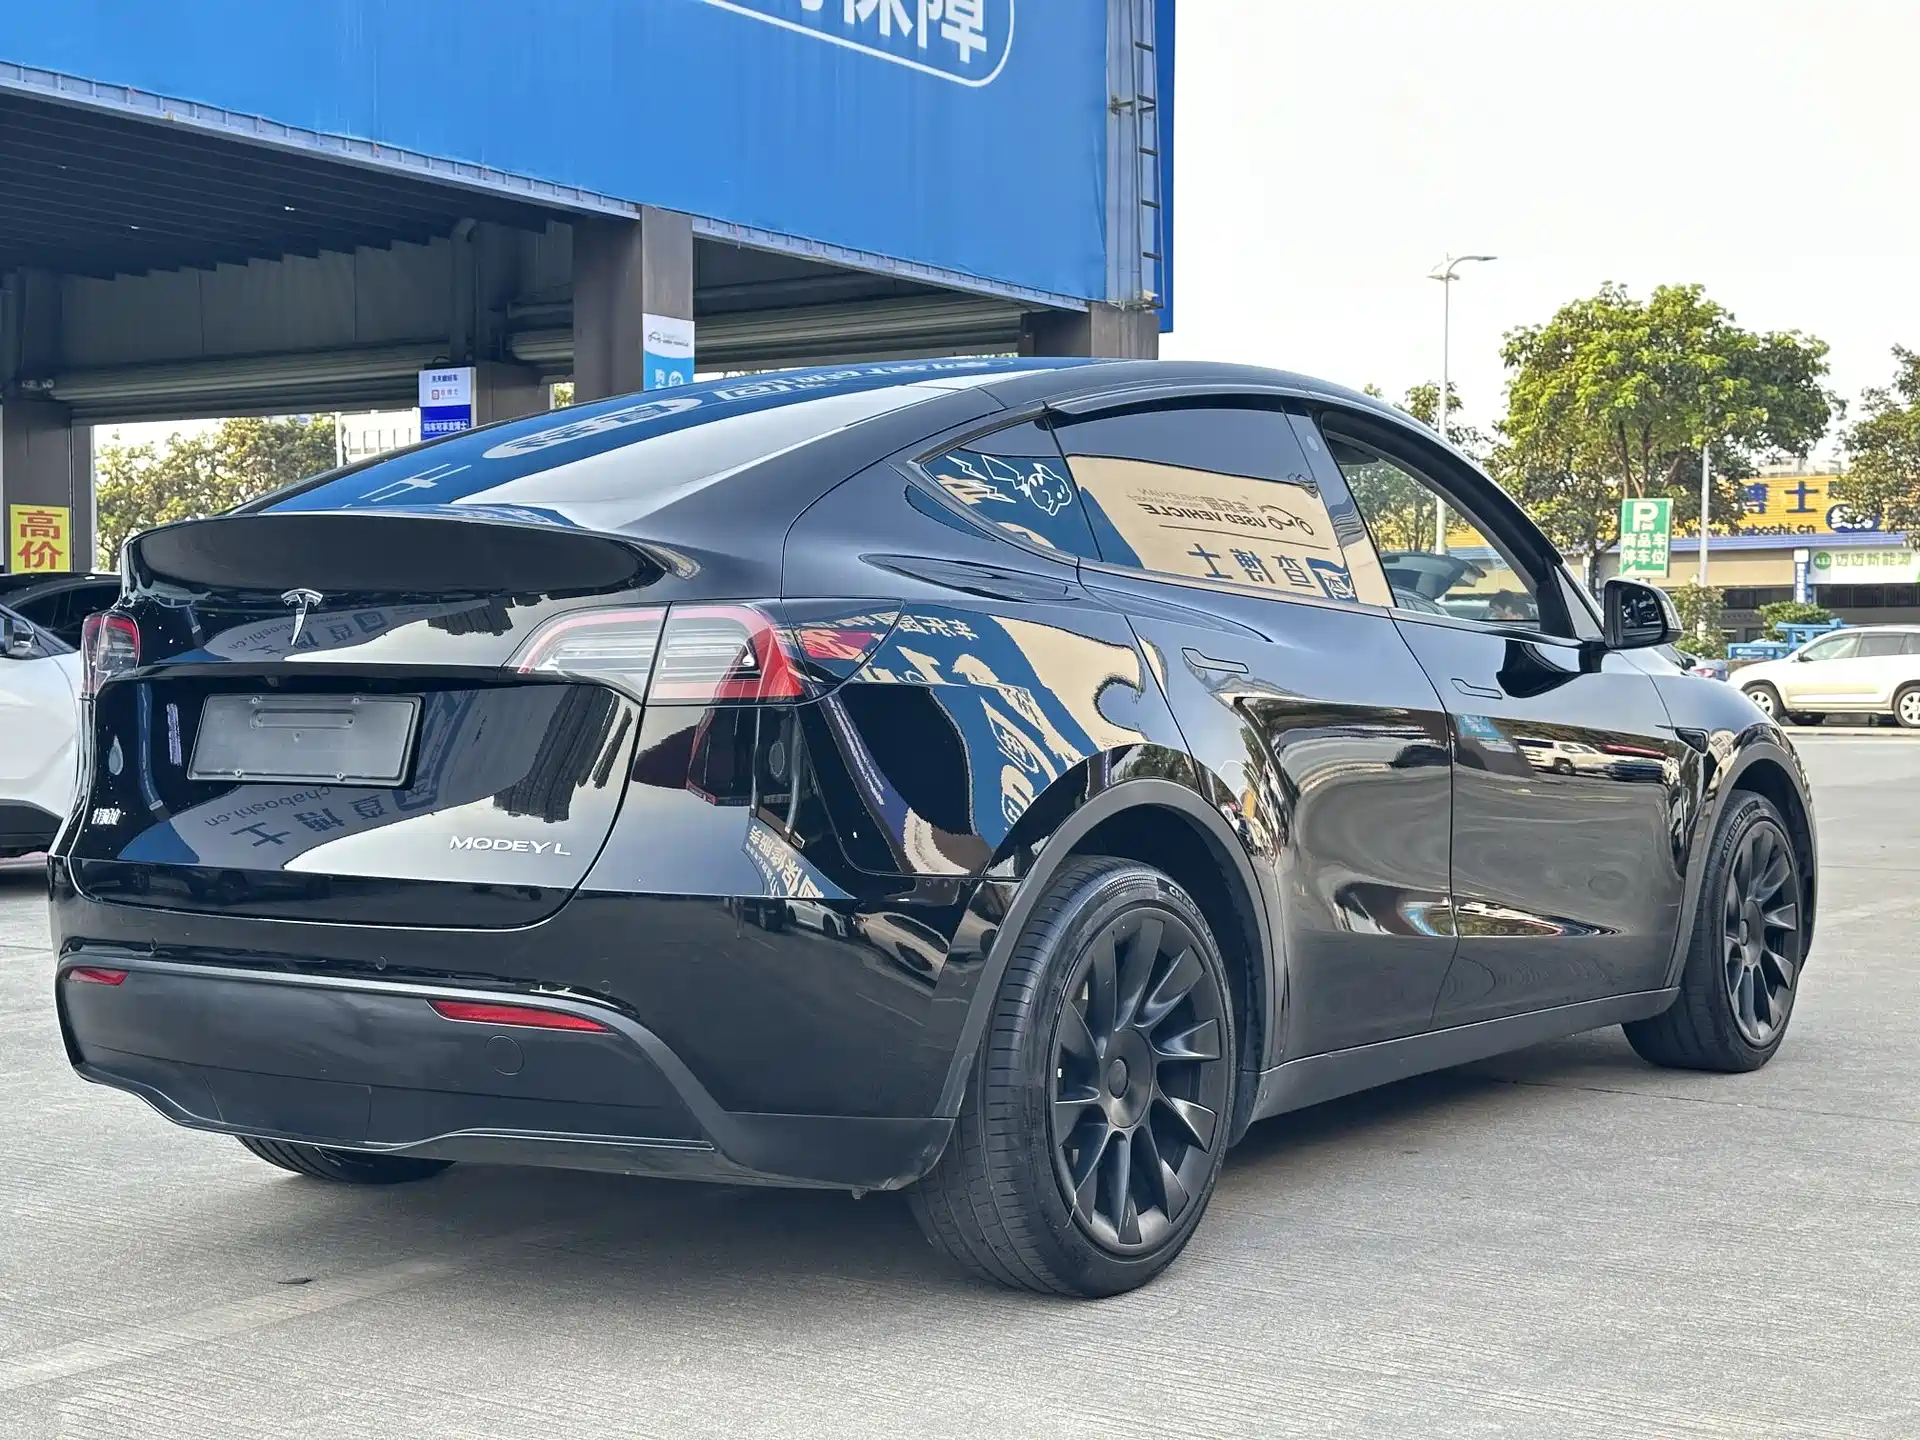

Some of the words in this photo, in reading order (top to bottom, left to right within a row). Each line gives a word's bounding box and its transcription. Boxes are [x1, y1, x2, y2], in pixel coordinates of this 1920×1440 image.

[1632, 502, 1659, 532] P
[17, 510, 64, 570] 高价
[1622, 532, 1667, 548] 商品车
[1622, 548, 1667, 566] 停车位
